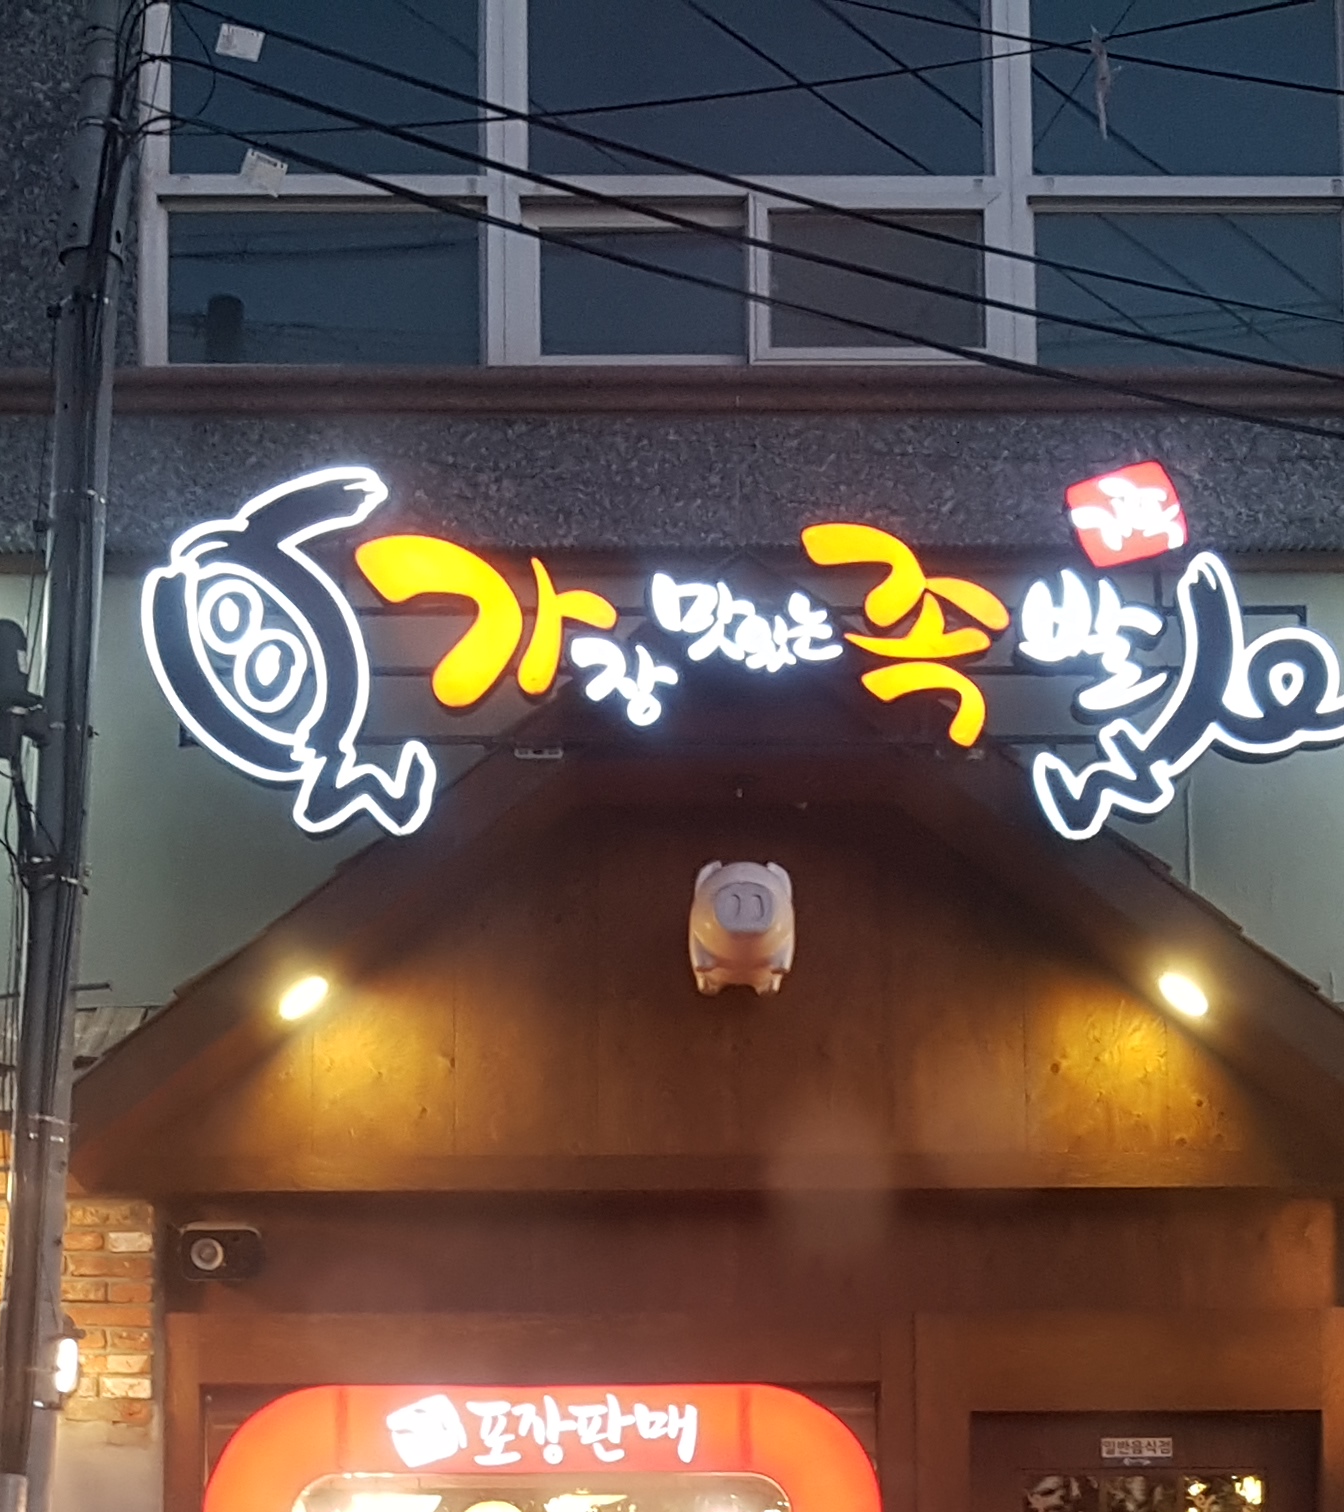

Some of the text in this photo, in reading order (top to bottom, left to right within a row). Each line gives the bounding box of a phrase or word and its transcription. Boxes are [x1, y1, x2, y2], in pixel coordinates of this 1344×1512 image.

[354, 522, 1165, 727] 가장 맛있는 족발
[465, 1392, 699, 1466] 포장판매
